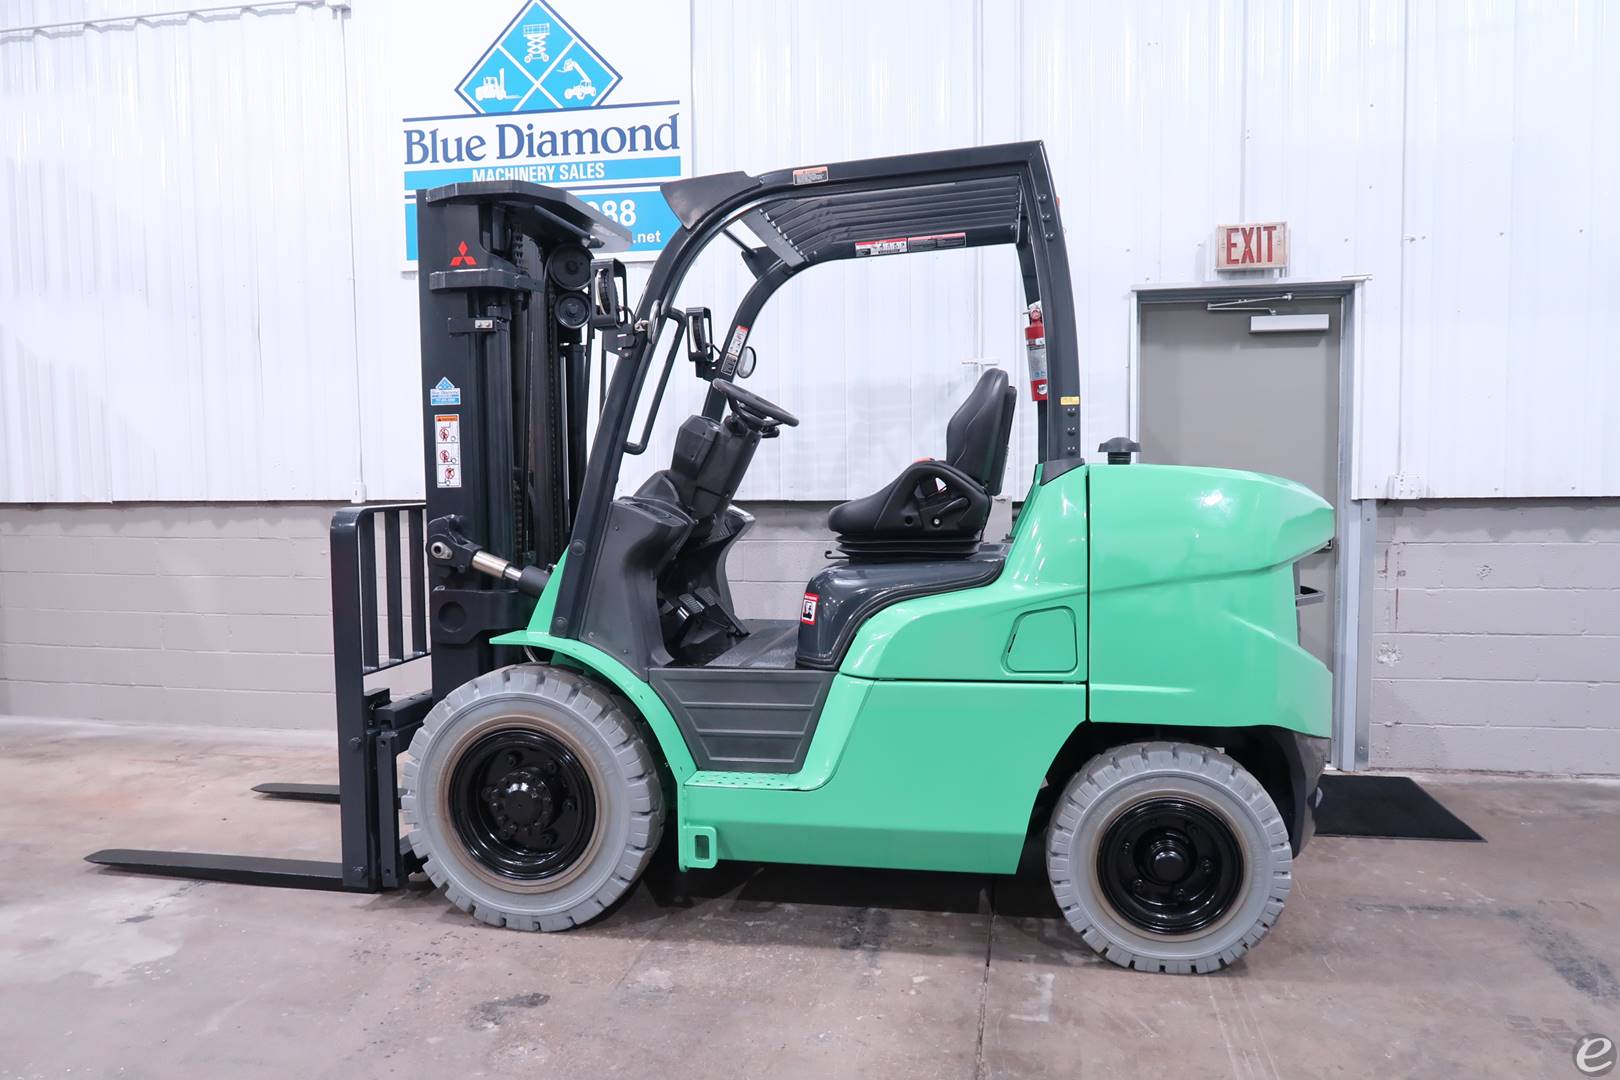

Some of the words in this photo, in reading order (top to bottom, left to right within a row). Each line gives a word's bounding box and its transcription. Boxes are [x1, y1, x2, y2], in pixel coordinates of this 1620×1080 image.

[404, 128, 486, 165] Blue
[496, 113, 680, 160] Diamond
[472, 165, 556, 182] MACHINERY
[560, 162, 605, 180] SALES
[1226, 225, 1277, 265] EXIT
